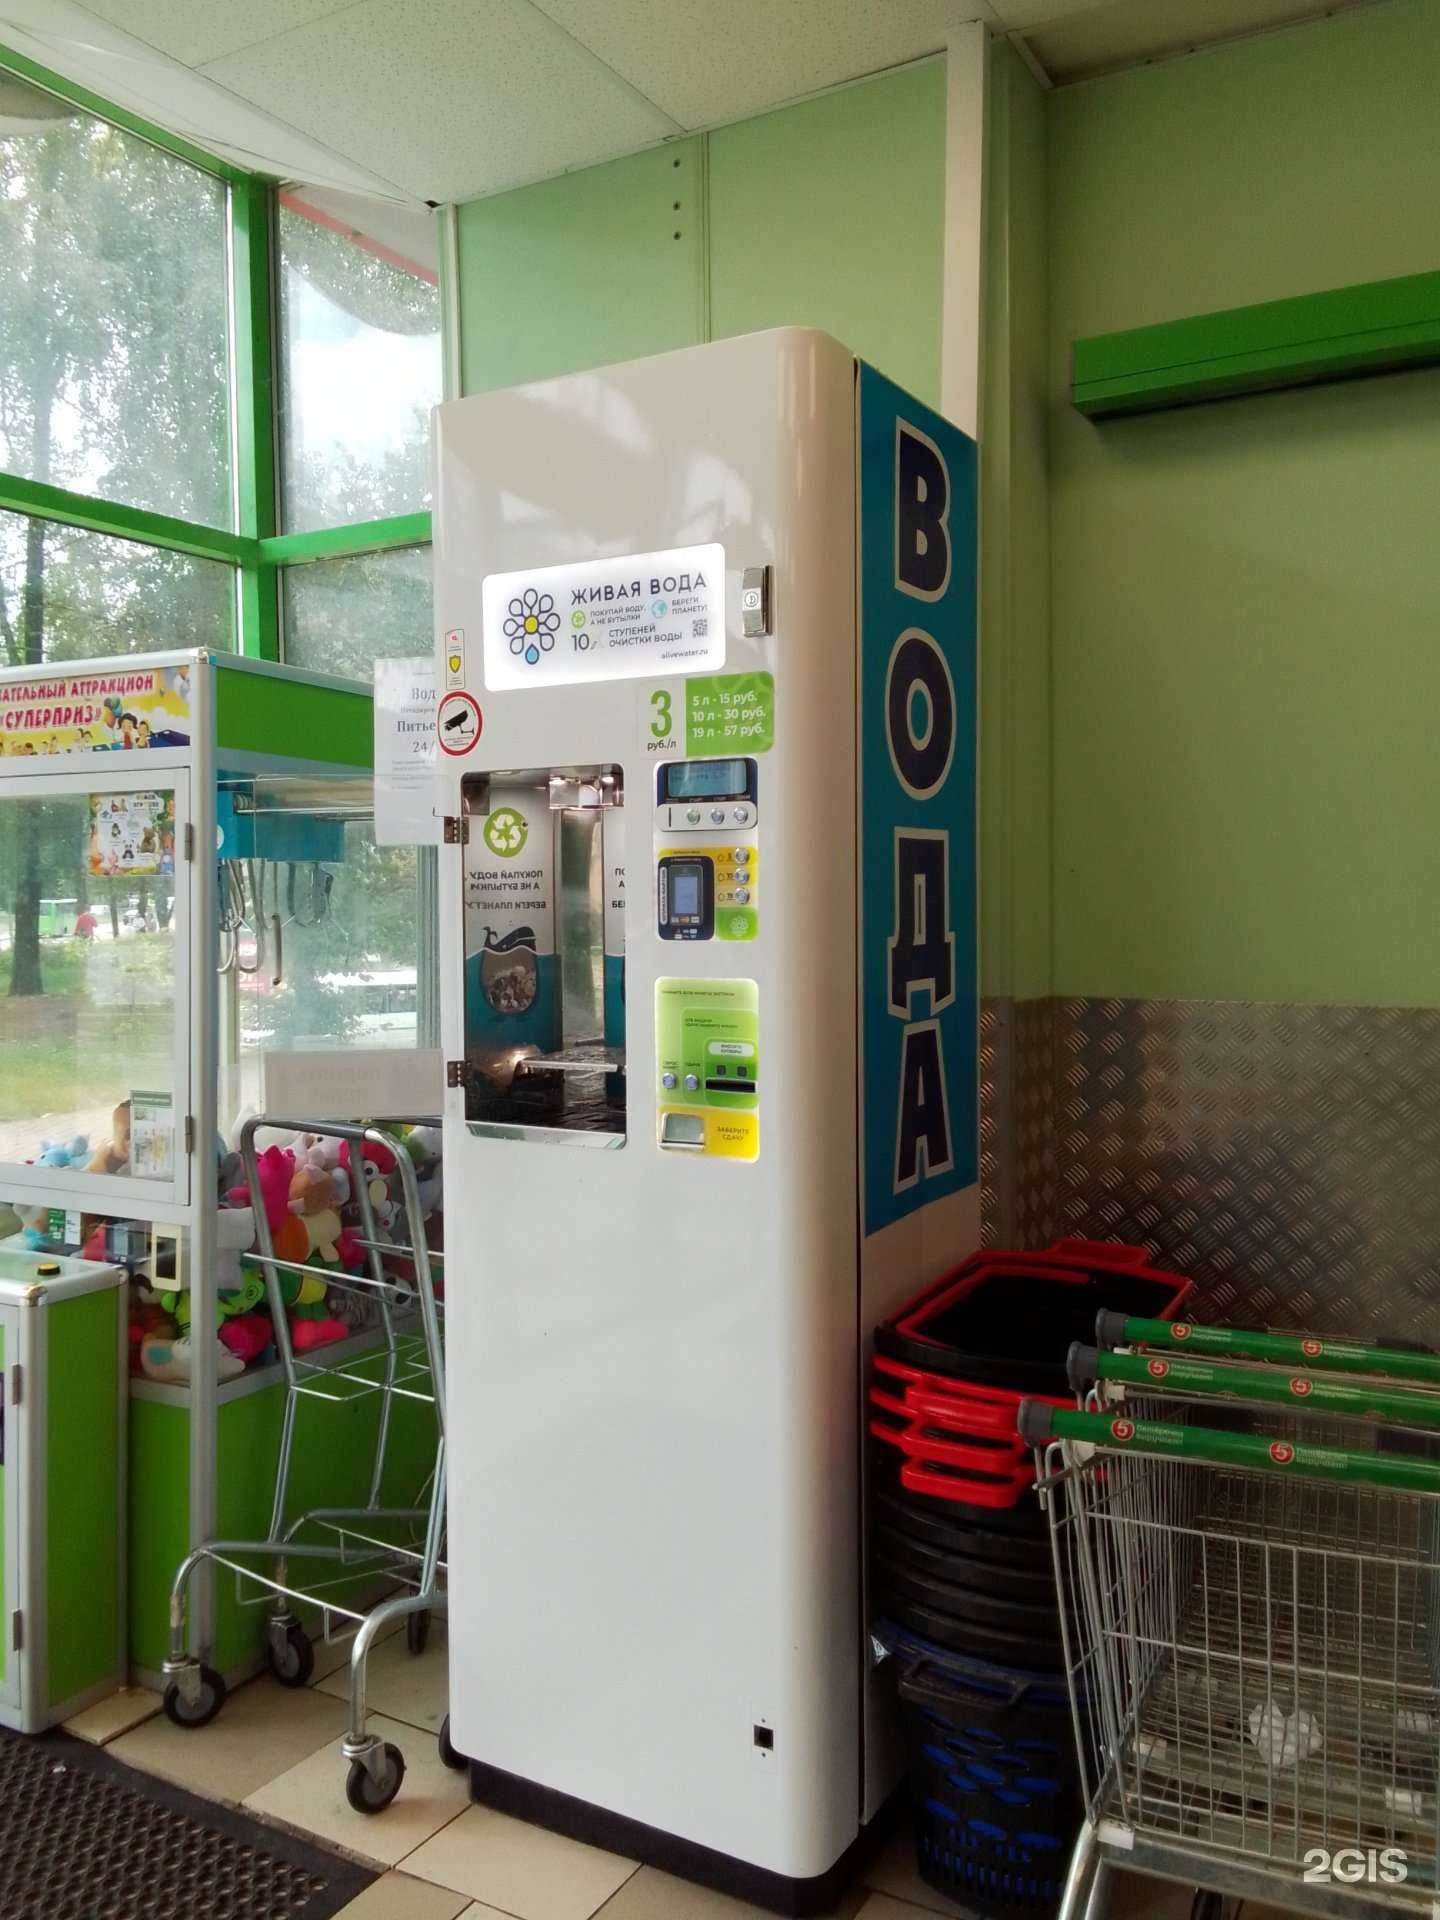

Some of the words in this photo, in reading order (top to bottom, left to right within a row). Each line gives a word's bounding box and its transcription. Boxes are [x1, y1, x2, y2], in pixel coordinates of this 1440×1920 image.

[571, 581, 641, 605] ЖИВАЯ
[650, 572, 707, 595] ВОДА
[671, 597, 699, 606] БЕРЕГИ
[590, 605, 624, 617] ПОКУПАЙ
[607, 614, 642, 624] БУТЫЛКИ
[609, 624, 656, 637] СТУПЕНЕЙ
[571, 633, 590, 651] 10
[609, 635, 652, 648] ОЧИСТКИ
[653, 632, 683, 644] ВОДЫ
[0, 680, 66, 702] АТЕЛЬНЫЙ
[71, 675, 154, 696] АТТРАКЦИОН
[692, 695, 700, 706] 5
[702, 696, 710, 705] л
[719, 693, 731, 704] 15
[733, 690, 758, 704] руб.
[650, 689, 672, 738] 3
[692, 711, 705, 722] 10
[706, 712, 715, 721] л
[724, 708, 738, 720] 30
[741, 706, 767, 720] руб.
[692, 727, 705, 738] 19
[706, 728, 715, 737] л
[724, 725, 738, 736] 57
[740, 722, 766, 736] руб.
[647, 738, 677, 751] руб./л
[885, 415, 957, 1194] ВОДА
